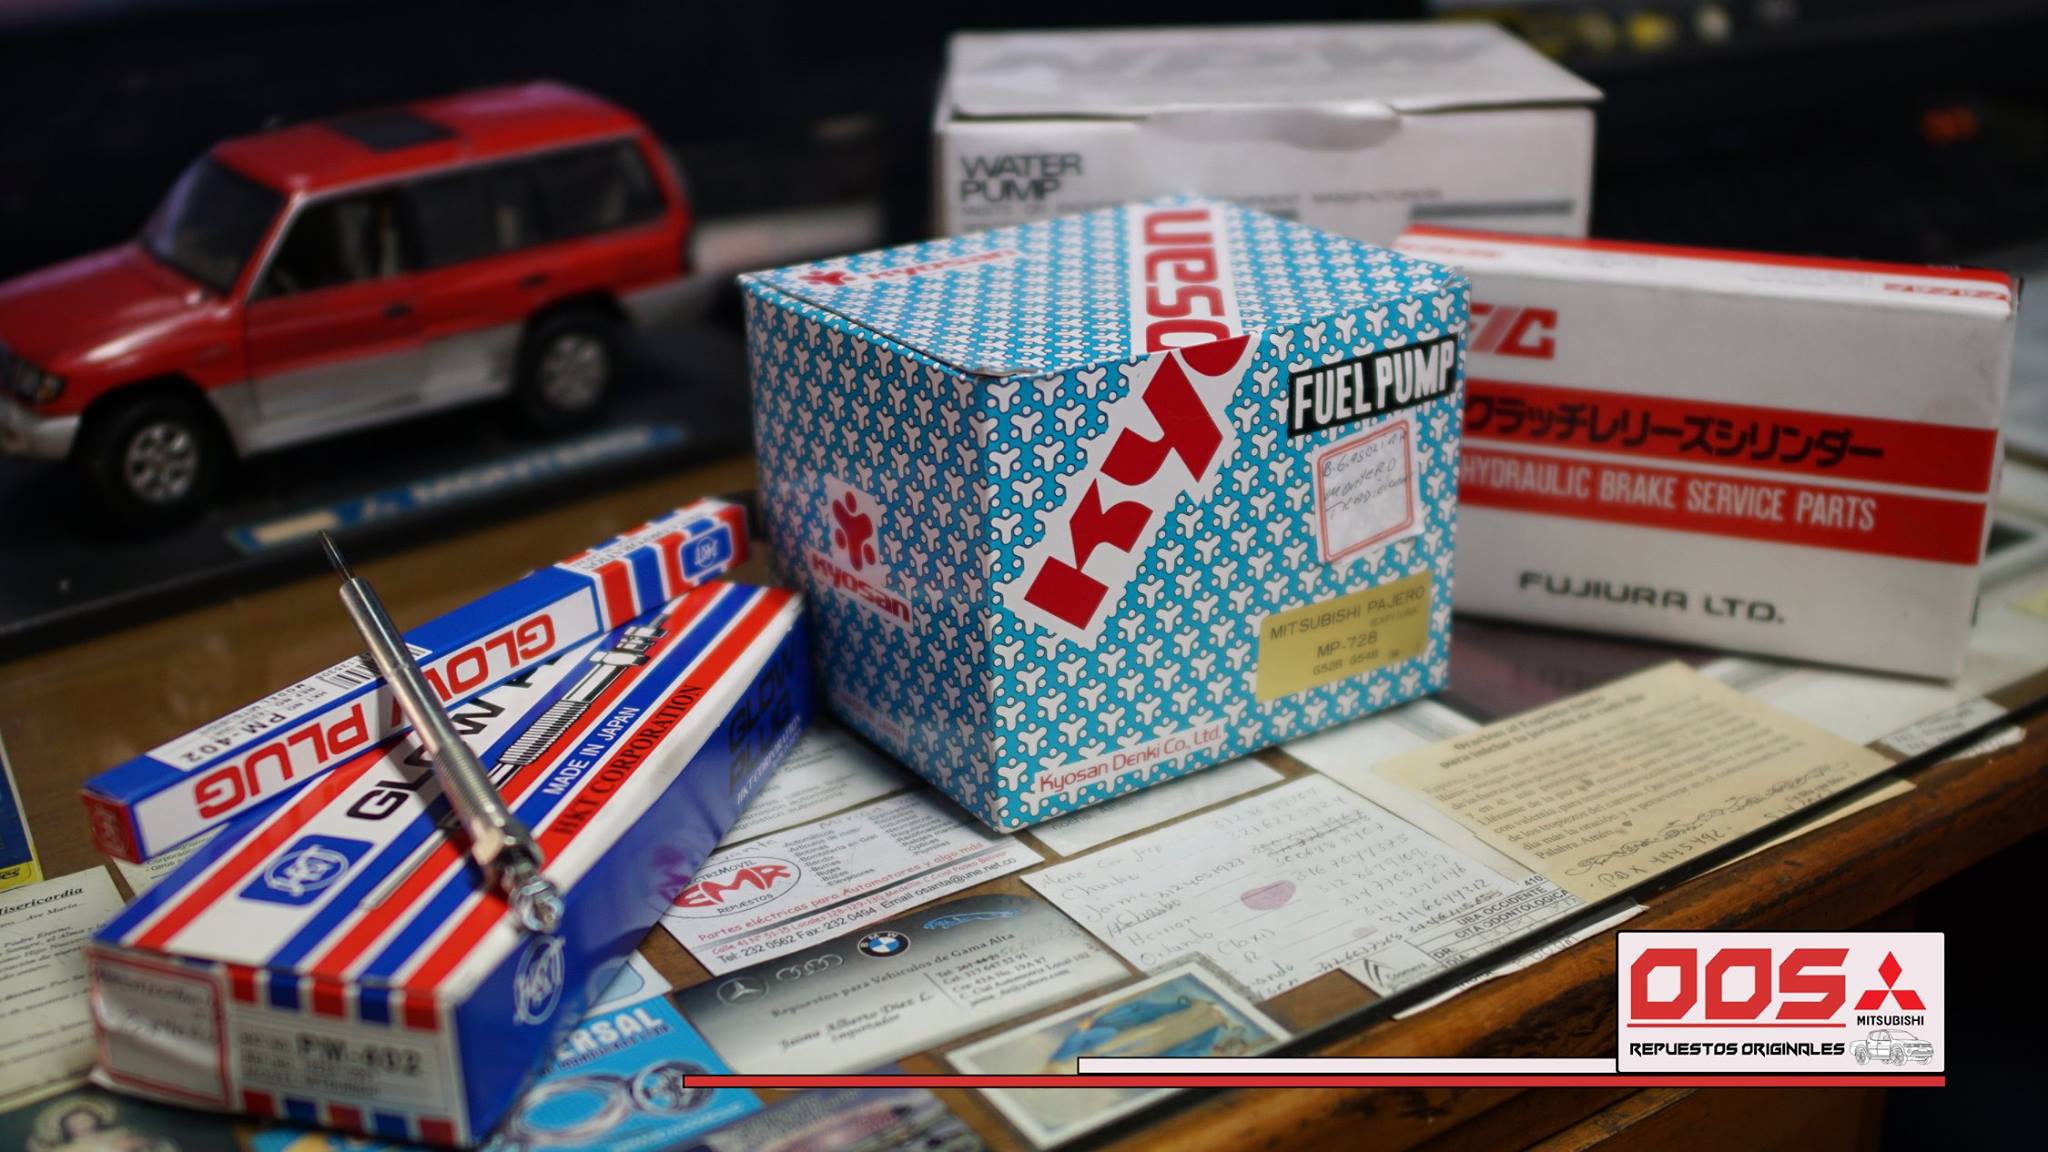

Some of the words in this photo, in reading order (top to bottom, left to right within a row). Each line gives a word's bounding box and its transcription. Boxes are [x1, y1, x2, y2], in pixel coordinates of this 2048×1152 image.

[960, 153, 1083, 179] WATER
[960, 178, 1061, 202] PUMP
[1294, 362, 1372, 431] FUEL
[1374, 340, 1455, 410] PUMP
[1463, 395, 1885, 467] クラッチレリーズシリンダー
[1459, 453, 1592, 500] HYDRAULIC
[1600, 470, 1678, 509] BRAKE
[1687, 479, 1784, 521] SERVICE
[1794, 492, 1877, 532] PARTS
[811, 552, 912, 625] Kyosan
[1269, 605, 1362, 641] MITSUBISHI
[1367, 585, 1426, 616] PAJERO
[1519, 571, 1688, 612] FUJIURA
[1702, 596, 1787, 626] LTD.
[1316, 630, 1379, 659] MP-728
[180, 712, 287, 763] PM-402
[192, 702, 370, 821] PLUG
[541, 757, 590, 797] MADE
[579, 743, 606, 758] IN
[597, 706, 642, 743] JAPAN
[553, 794, 593, 836] HKT
[590, 683, 703, 797] CORPORATION
[1039, 762, 1109, 793] Kyosan
[1112, 745, 1160, 771] Denki
[698, 922, 742, 942] Partes
[745, 904, 808, 928] eléctricas
[810, 892, 840, 910] para
[842, 863, 922, 896] Automotores
[716, 892, 774, 915] REPUESTOS
[1457, 912, 1482, 927] UBA
[1482, 886, 1548, 915] OCCIDENTE
[1523, 875, 1545, 887] 410
[715, 952, 739, 964] Tel:
[740, 944, 766, 957] 232
[765, 934, 797, 950] 0562
[795, 926, 822, 942] Fax:
[822, 917, 848, 931] 232
[849, 907, 878, 922] 0494
[881, 891, 914, 910] Email
[1453, 924, 1483, 940] CITA
[1483, 889, 1570, 928] ODONTOLOGICA
[840, 981, 870, 997] para
[933, 954, 949, 965] de
[950, 942, 988, 958] Gama
[989, 932, 1016, 946] Alta
